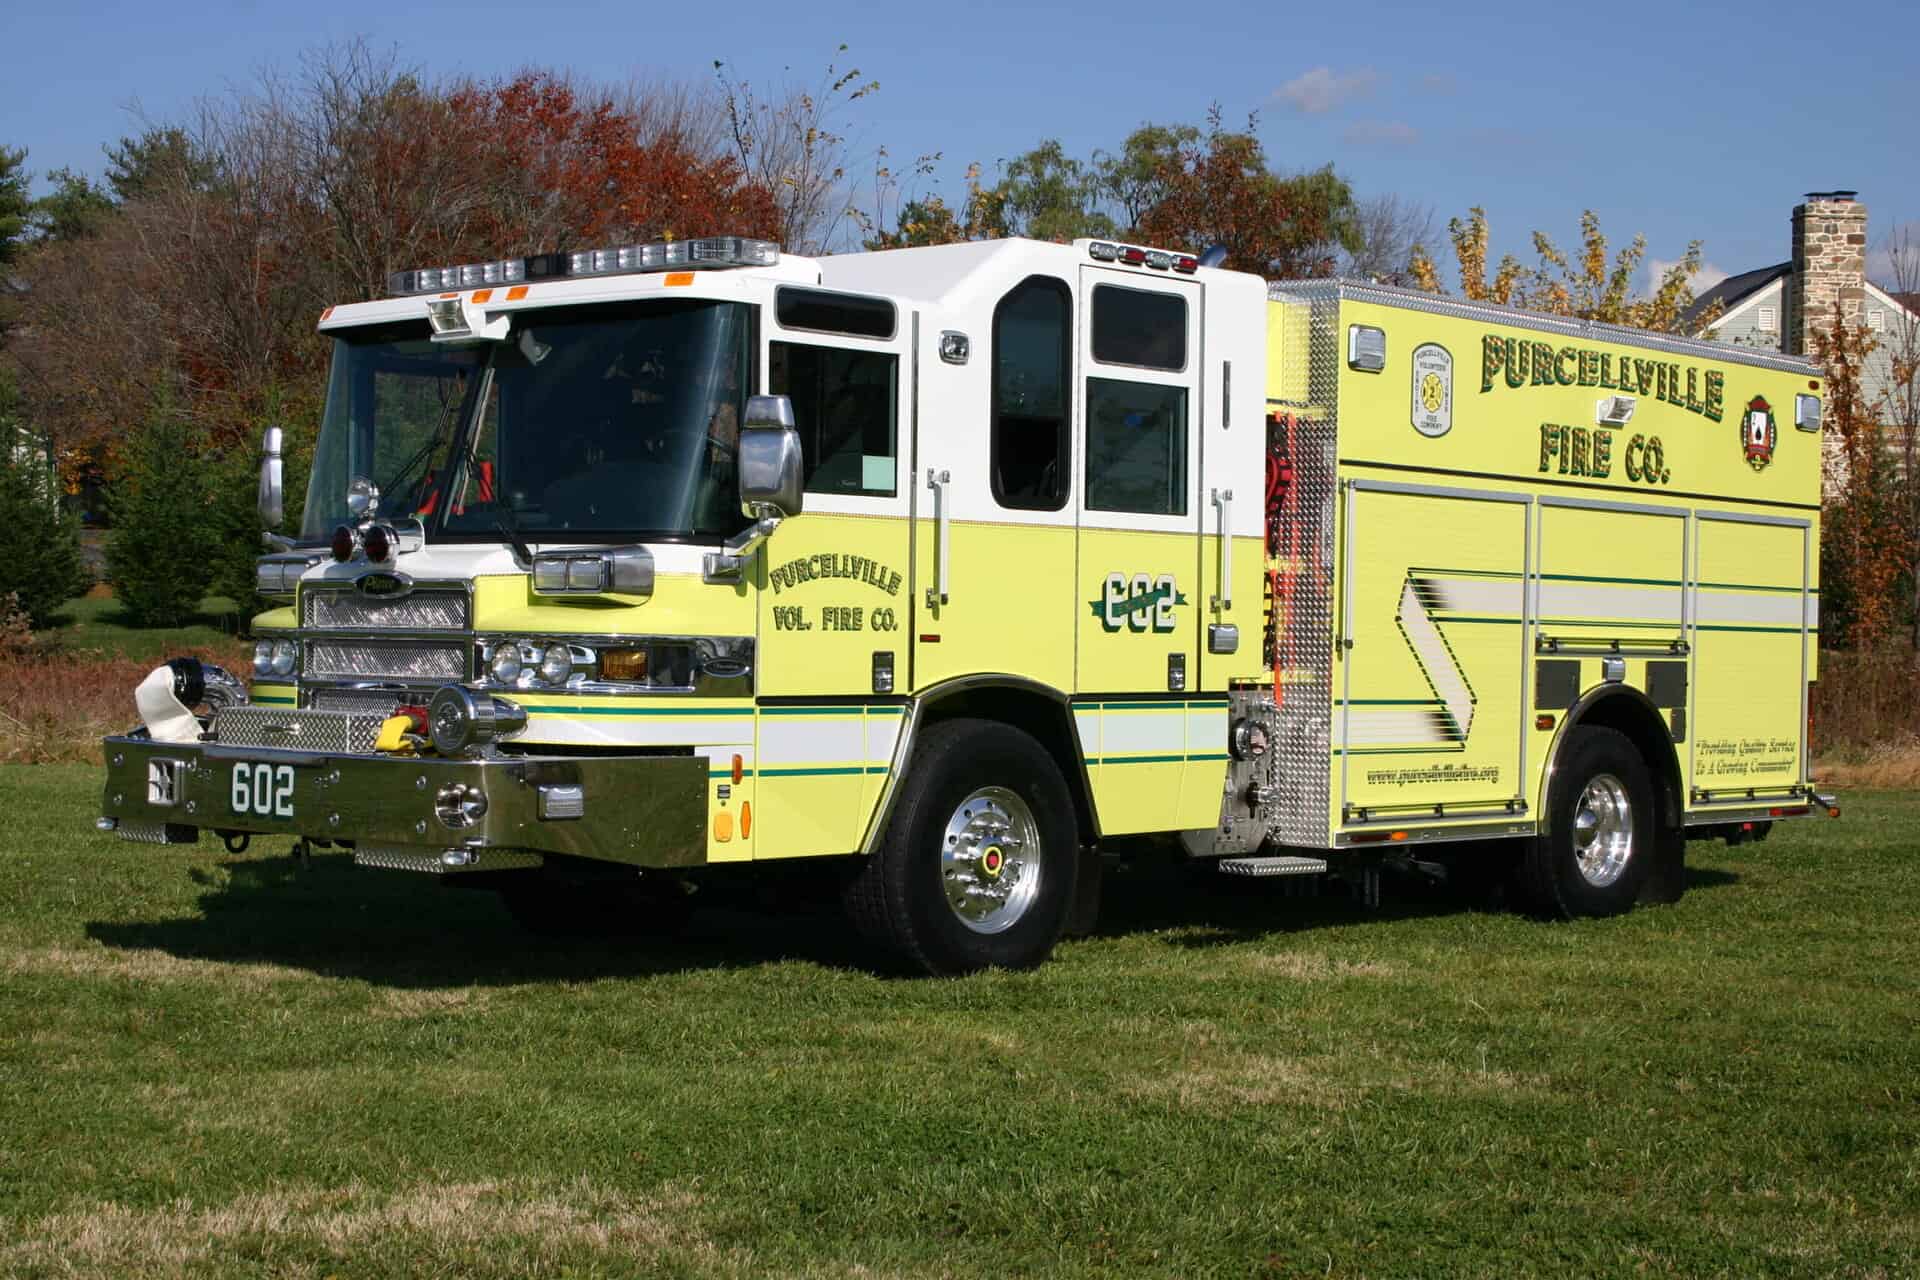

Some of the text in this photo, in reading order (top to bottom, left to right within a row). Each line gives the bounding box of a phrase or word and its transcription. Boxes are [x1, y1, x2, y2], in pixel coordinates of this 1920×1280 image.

[1480, 334, 1724, 423] PURCELLVILLE
[1538, 423, 1671, 484] FIRE CO.
[769, 553, 902, 596] PURCELLVILLE
[1102, 571, 1177, 633] 602
[773, 606, 898, 632] VOL. FIRE CO.
[232, 762, 295, 817] 602
